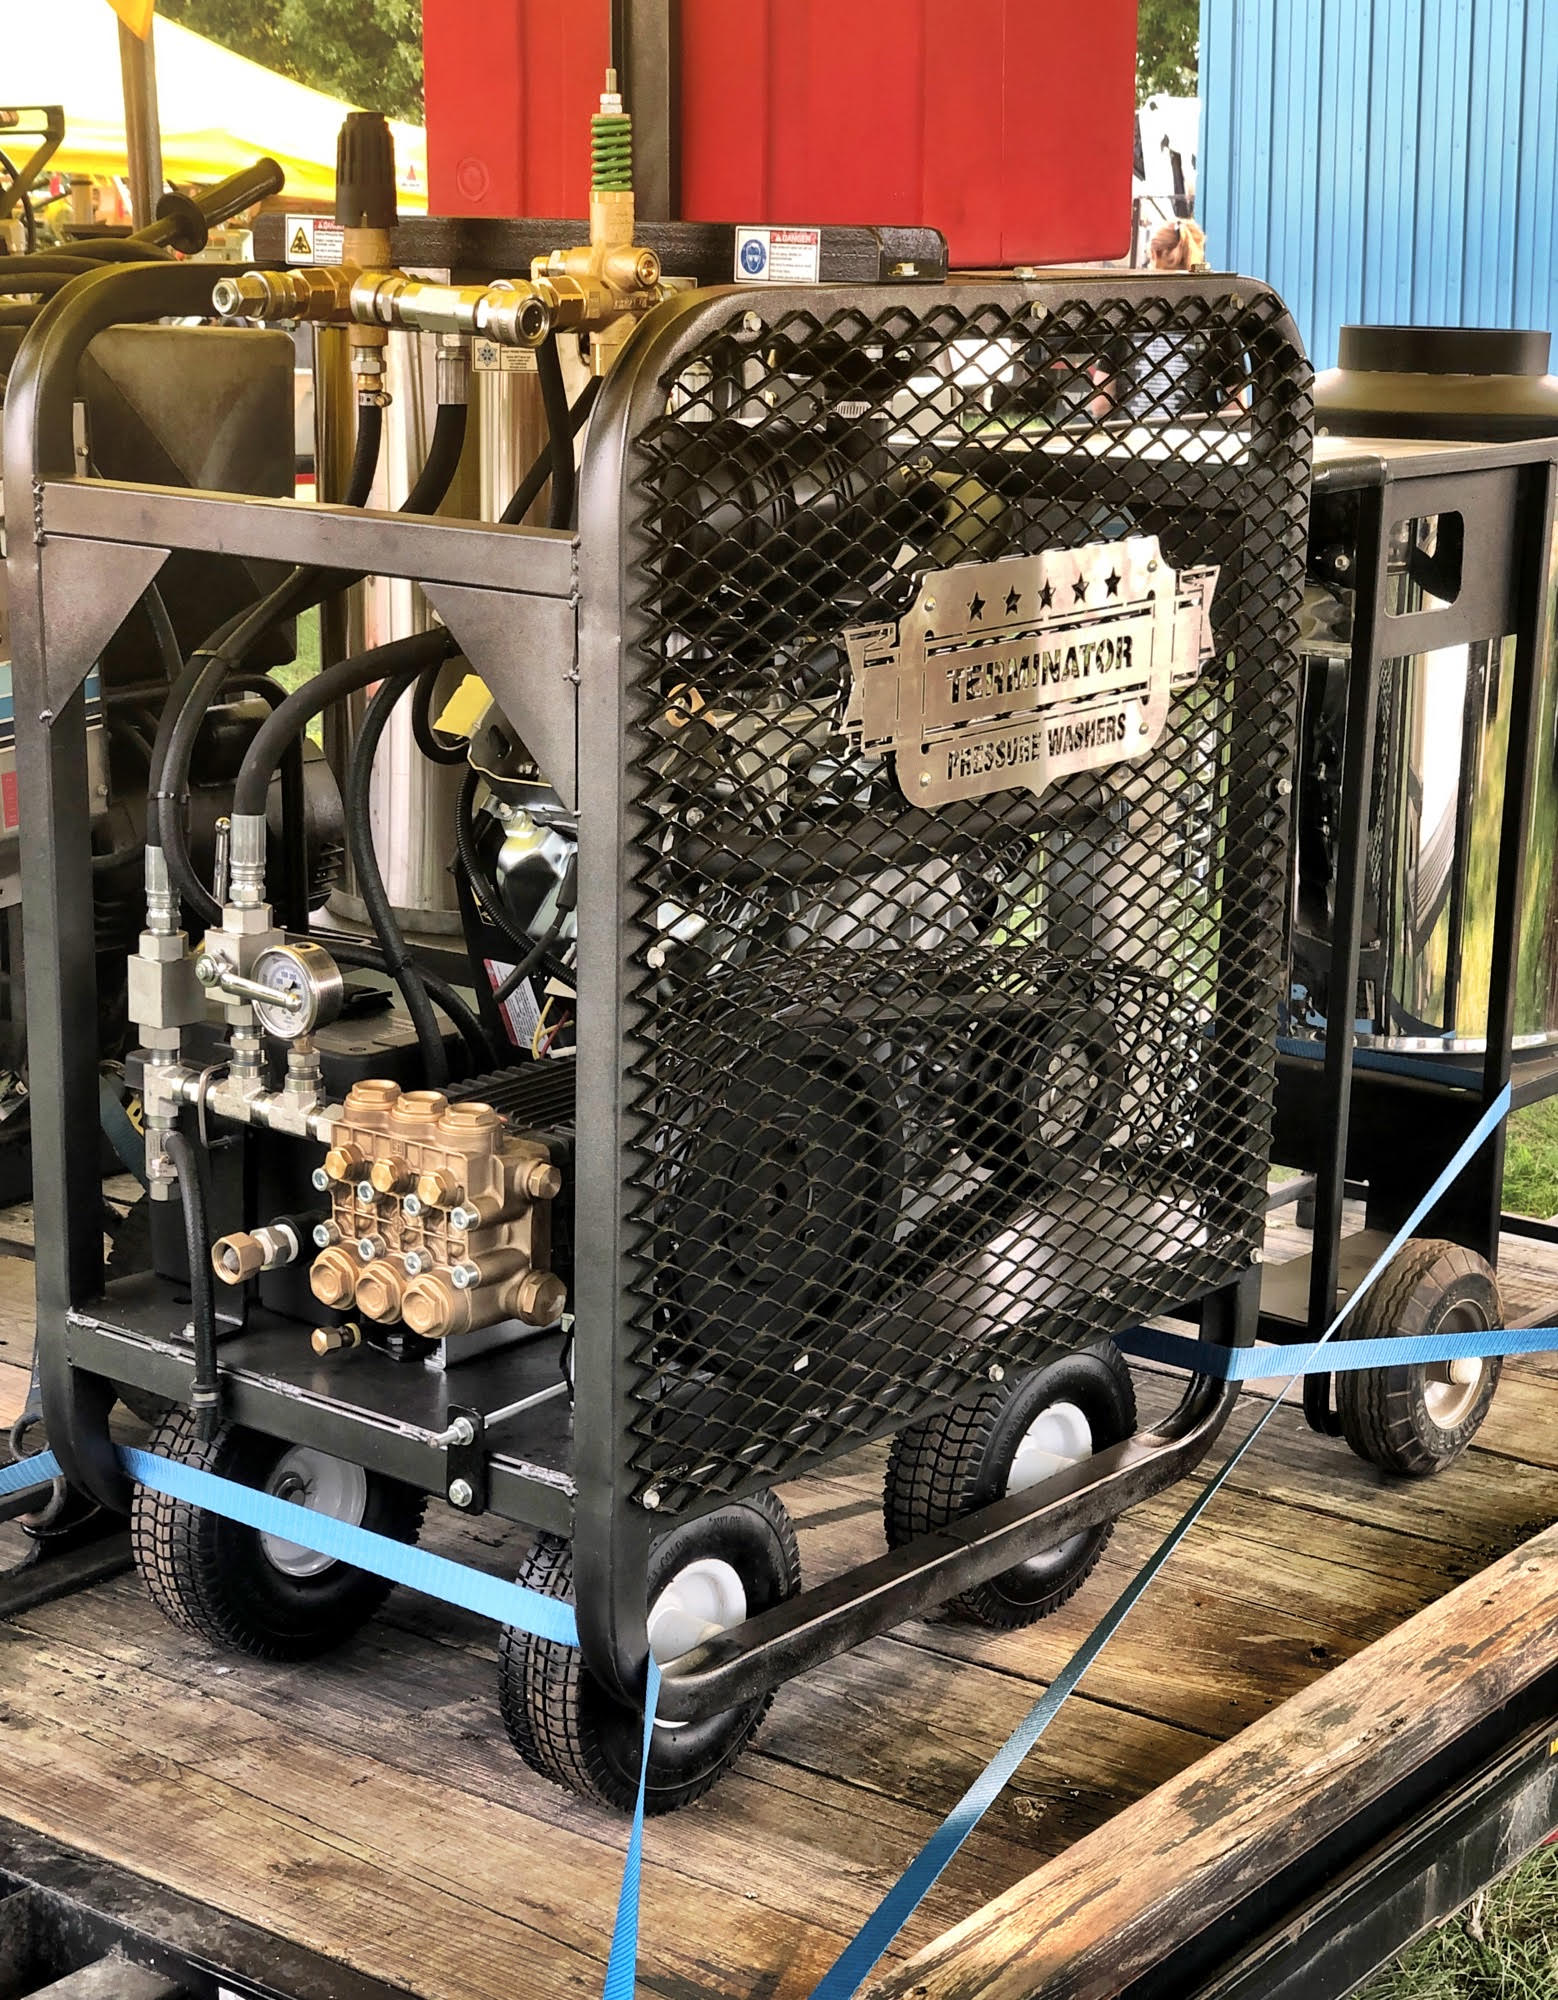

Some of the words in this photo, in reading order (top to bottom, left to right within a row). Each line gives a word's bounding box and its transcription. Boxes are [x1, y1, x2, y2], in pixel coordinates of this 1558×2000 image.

[946, 635, 1133, 704] TERMINATOR
[947, 732, 1042, 780] PRESSURE
[1047, 712, 1126, 757] WASHERS
